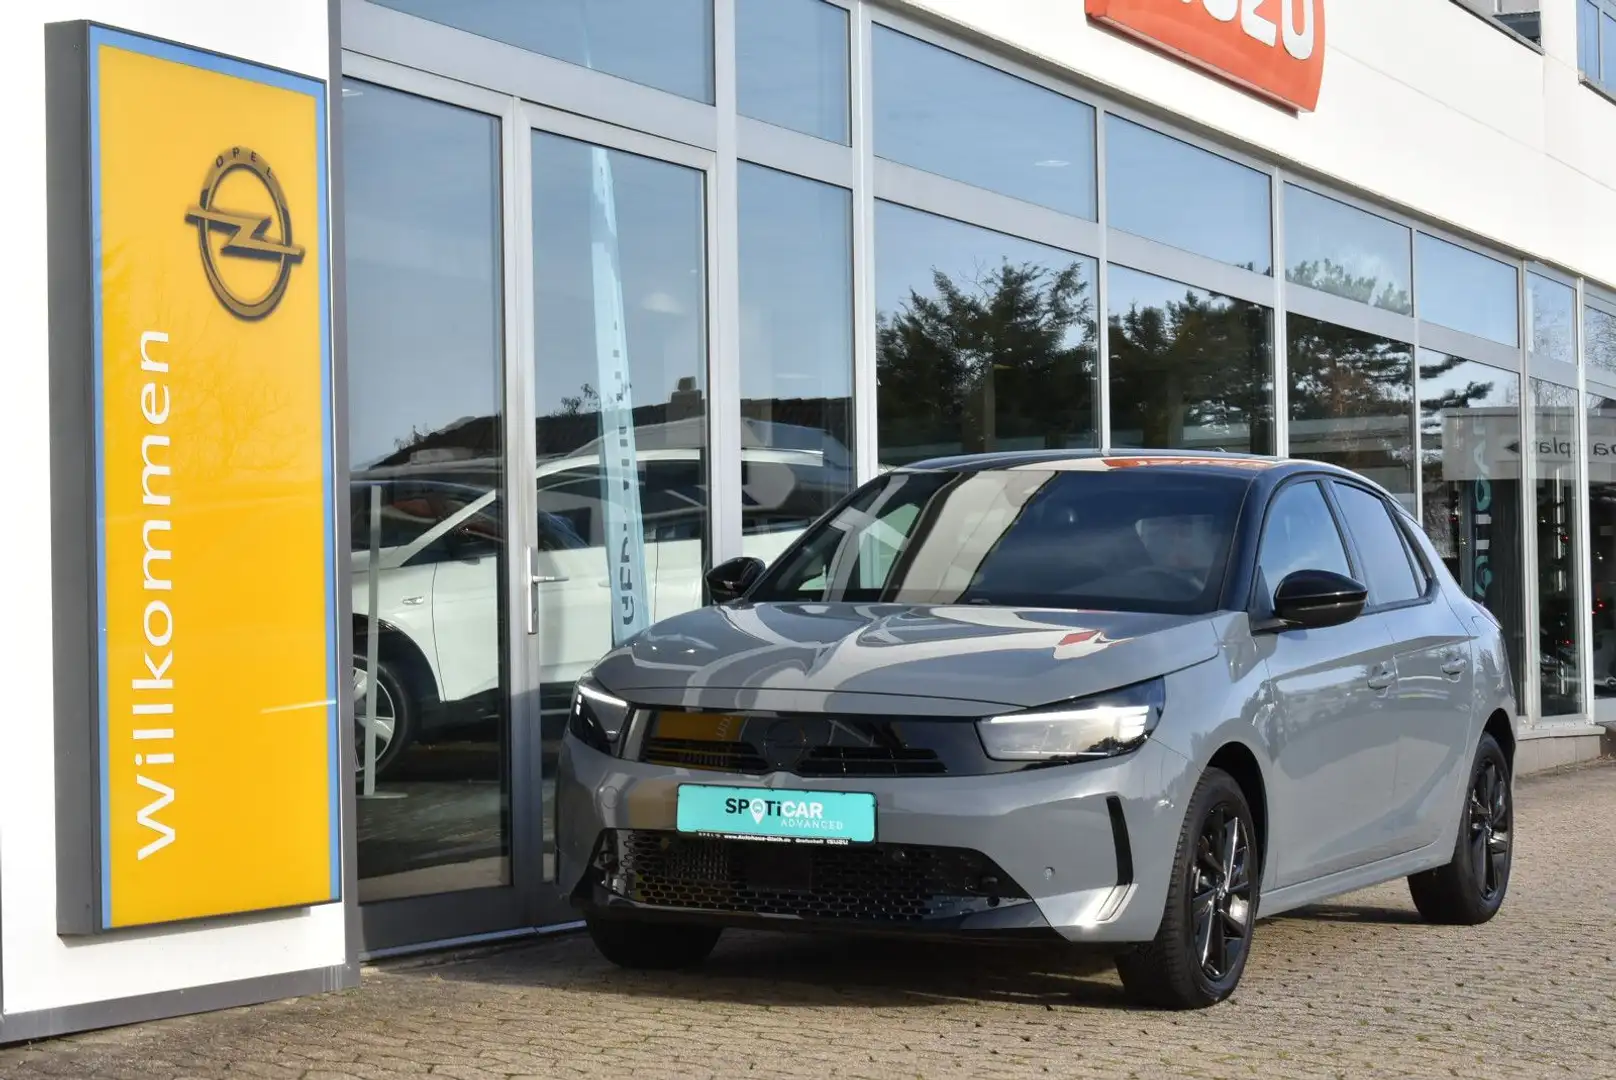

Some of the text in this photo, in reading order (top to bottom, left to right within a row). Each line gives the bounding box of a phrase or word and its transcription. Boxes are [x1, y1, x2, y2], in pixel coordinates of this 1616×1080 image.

[215, 147, 273, 179] OPEL
[132, 329, 176, 861] Willkommen
[780, 818, 844, 830] ADVANCED
